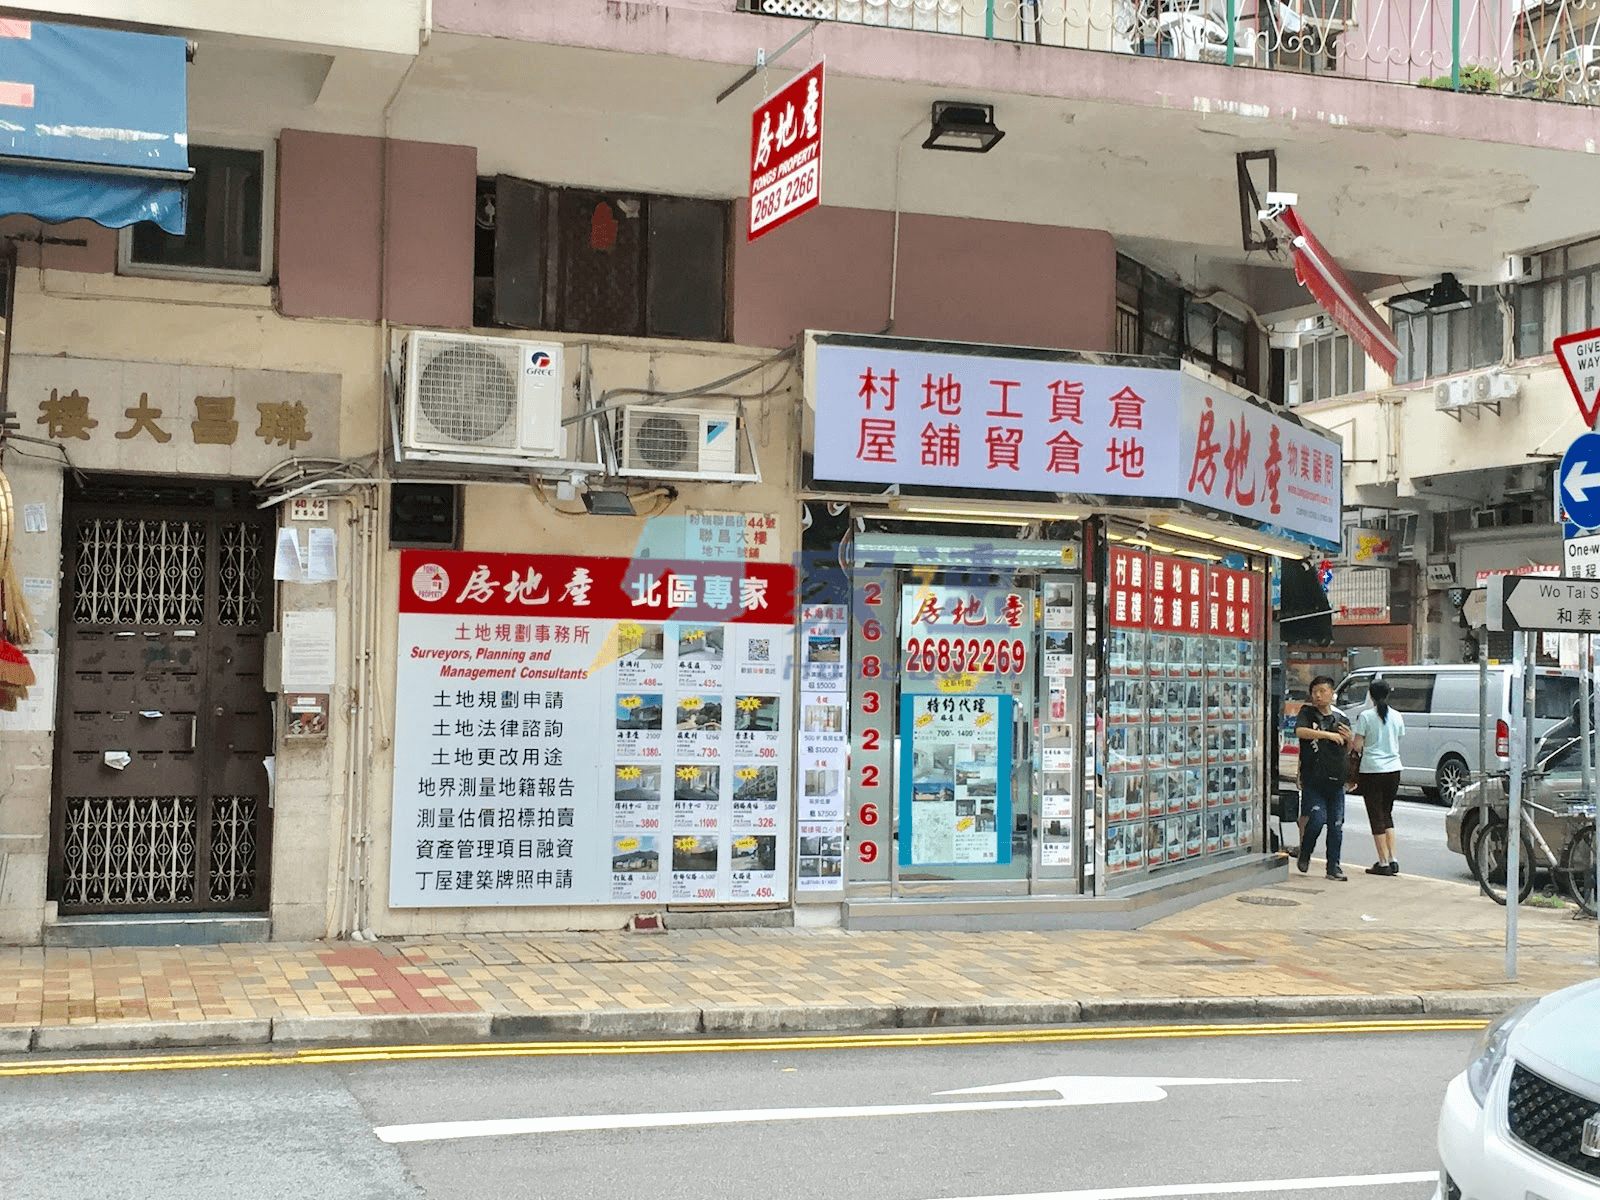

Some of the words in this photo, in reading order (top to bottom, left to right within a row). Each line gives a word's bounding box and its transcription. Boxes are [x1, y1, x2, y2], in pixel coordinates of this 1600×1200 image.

[754, 77, 819, 171] 房地產
[752, 167, 777, 193] FONGS
[778, 140, 819, 178] PROPERTY
[754, 187, 782, 224] 2683
[784, 168, 814, 208] 2266
[1577, 341, 1600, 356] GIVE
[526, 367, 554, 376] GREE
[1578, 356, 1600, 370] WAY
[1584, 376, 1594, 392] 讓
[1187, 396, 1282, 514] 房地產
[1287, 438, 1333, 490] 物業顧問
[312, 499, 324, 508] 42
[699, 529, 767, 545] 聯昌大樓
[418, 590, 443, 598] PROPERTY
[456, 565, 594, 606] 房地產
[631, 573, 769, 611] 北區專家
[1116, 554, 1127, 621] 村屋
[1539, 584, 1561, 598] Wo
[1566, 585, 1586, 599] Tai
[911, 593, 1025, 628] 房地產
[455, 622, 590, 644] 土地規劃事務所
[410, 646, 473, 661] Surveyors,
[476, 648, 527, 664] Planning
[530, 649, 551, 662] and
[906, 637, 1025, 675] 26832269
[439, 664, 516, 682] Management
[518, 667, 588, 680] Consultants
[433, 690, 564, 709] 土地規劃申請
[927, 697, 986, 713] 特約代理
[431, 719, 563, 738] 土地法律諮詢
[858, 582, 882, 863] 26832269
[431, 747, 563, 766] 土地更改用途
[702, 747, 718, 758] 730
[759, 748, 775, 758] 500
[418, 777, 575, 797] 地界測量地籍報告
[416, 808, 575, 828] 測量估價招標拍賣
[416, 839, 574, 859] 資產管理項目融資
[415, 869, 573, 891] 丁屋建築牌照申請
[640, 890, 657, 900] 900
[756, 888, 772, 898] 450
